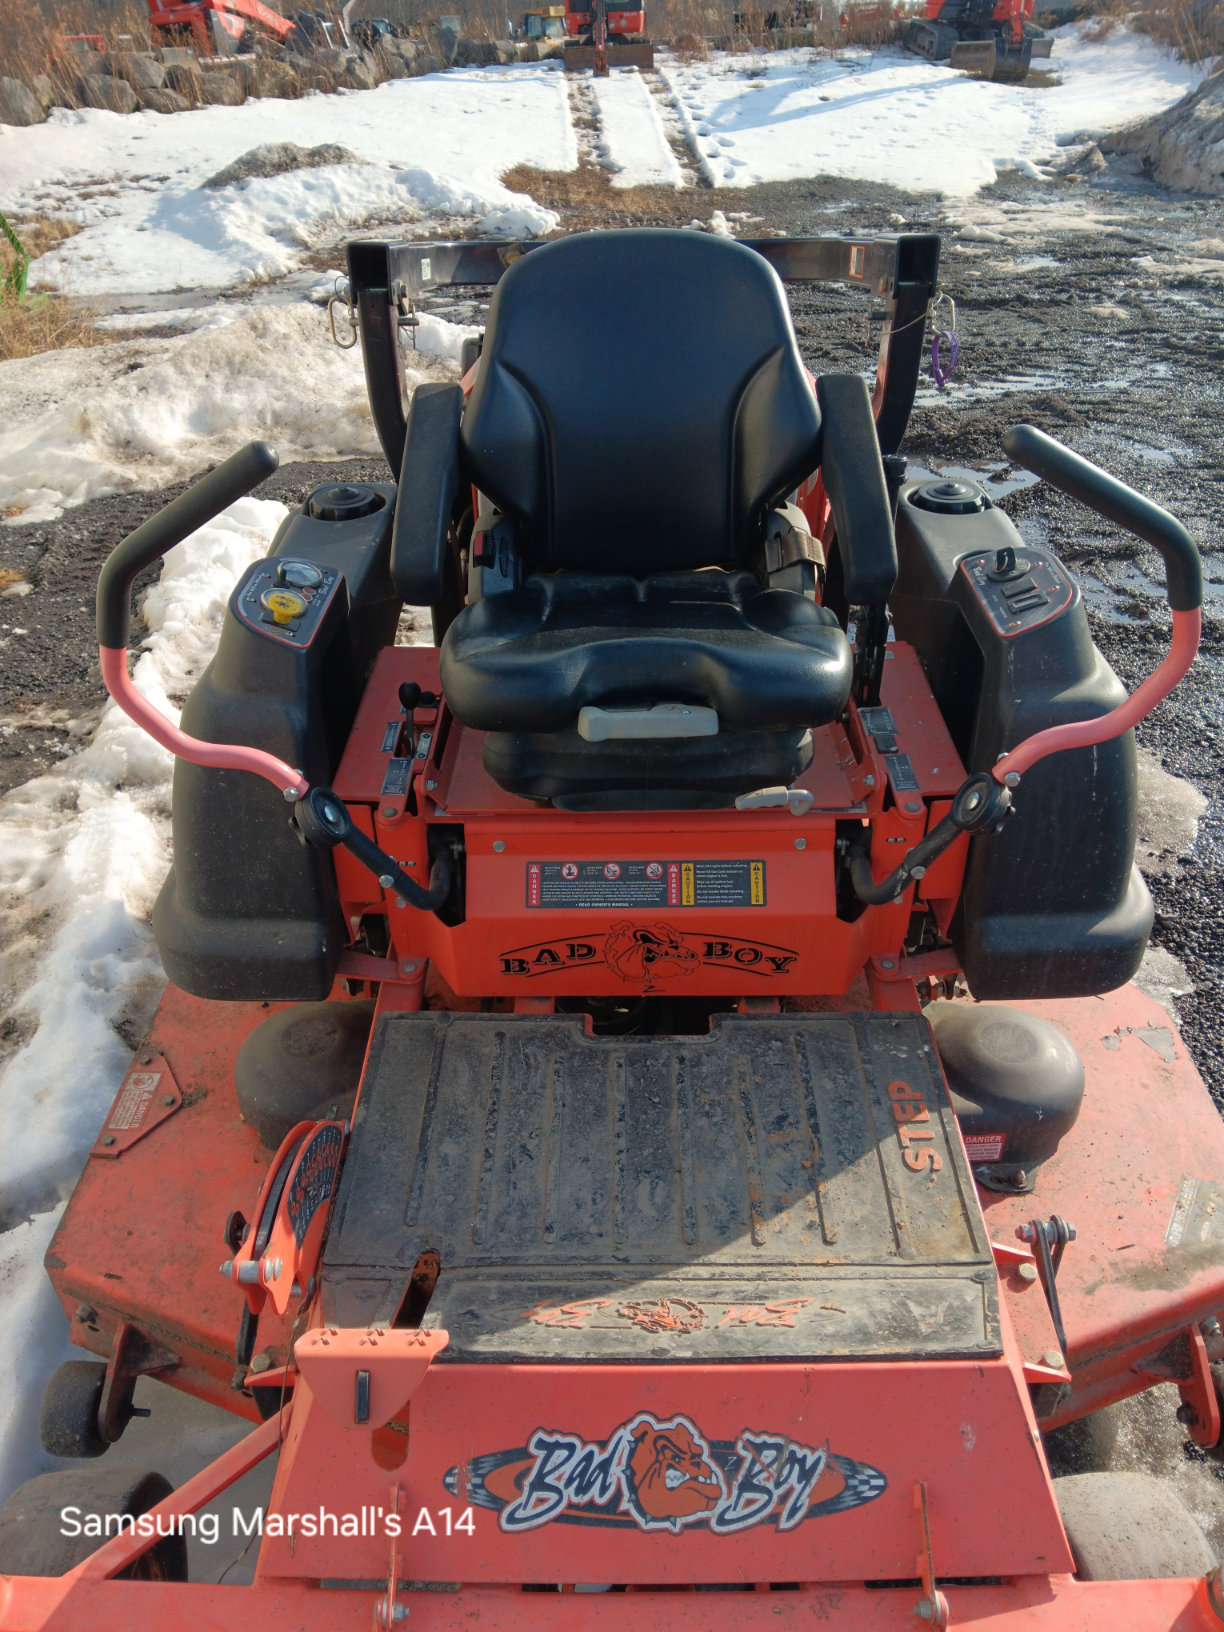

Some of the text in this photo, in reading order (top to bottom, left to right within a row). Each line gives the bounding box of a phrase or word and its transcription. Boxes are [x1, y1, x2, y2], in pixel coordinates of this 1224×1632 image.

[500, 942, 797, 975] BAD BOY
[130, 1102, 148, 1128] DANGER
[888, 1081, 942, 1170] STEP
[501, 1428, 828, 1534] Bad Boy
